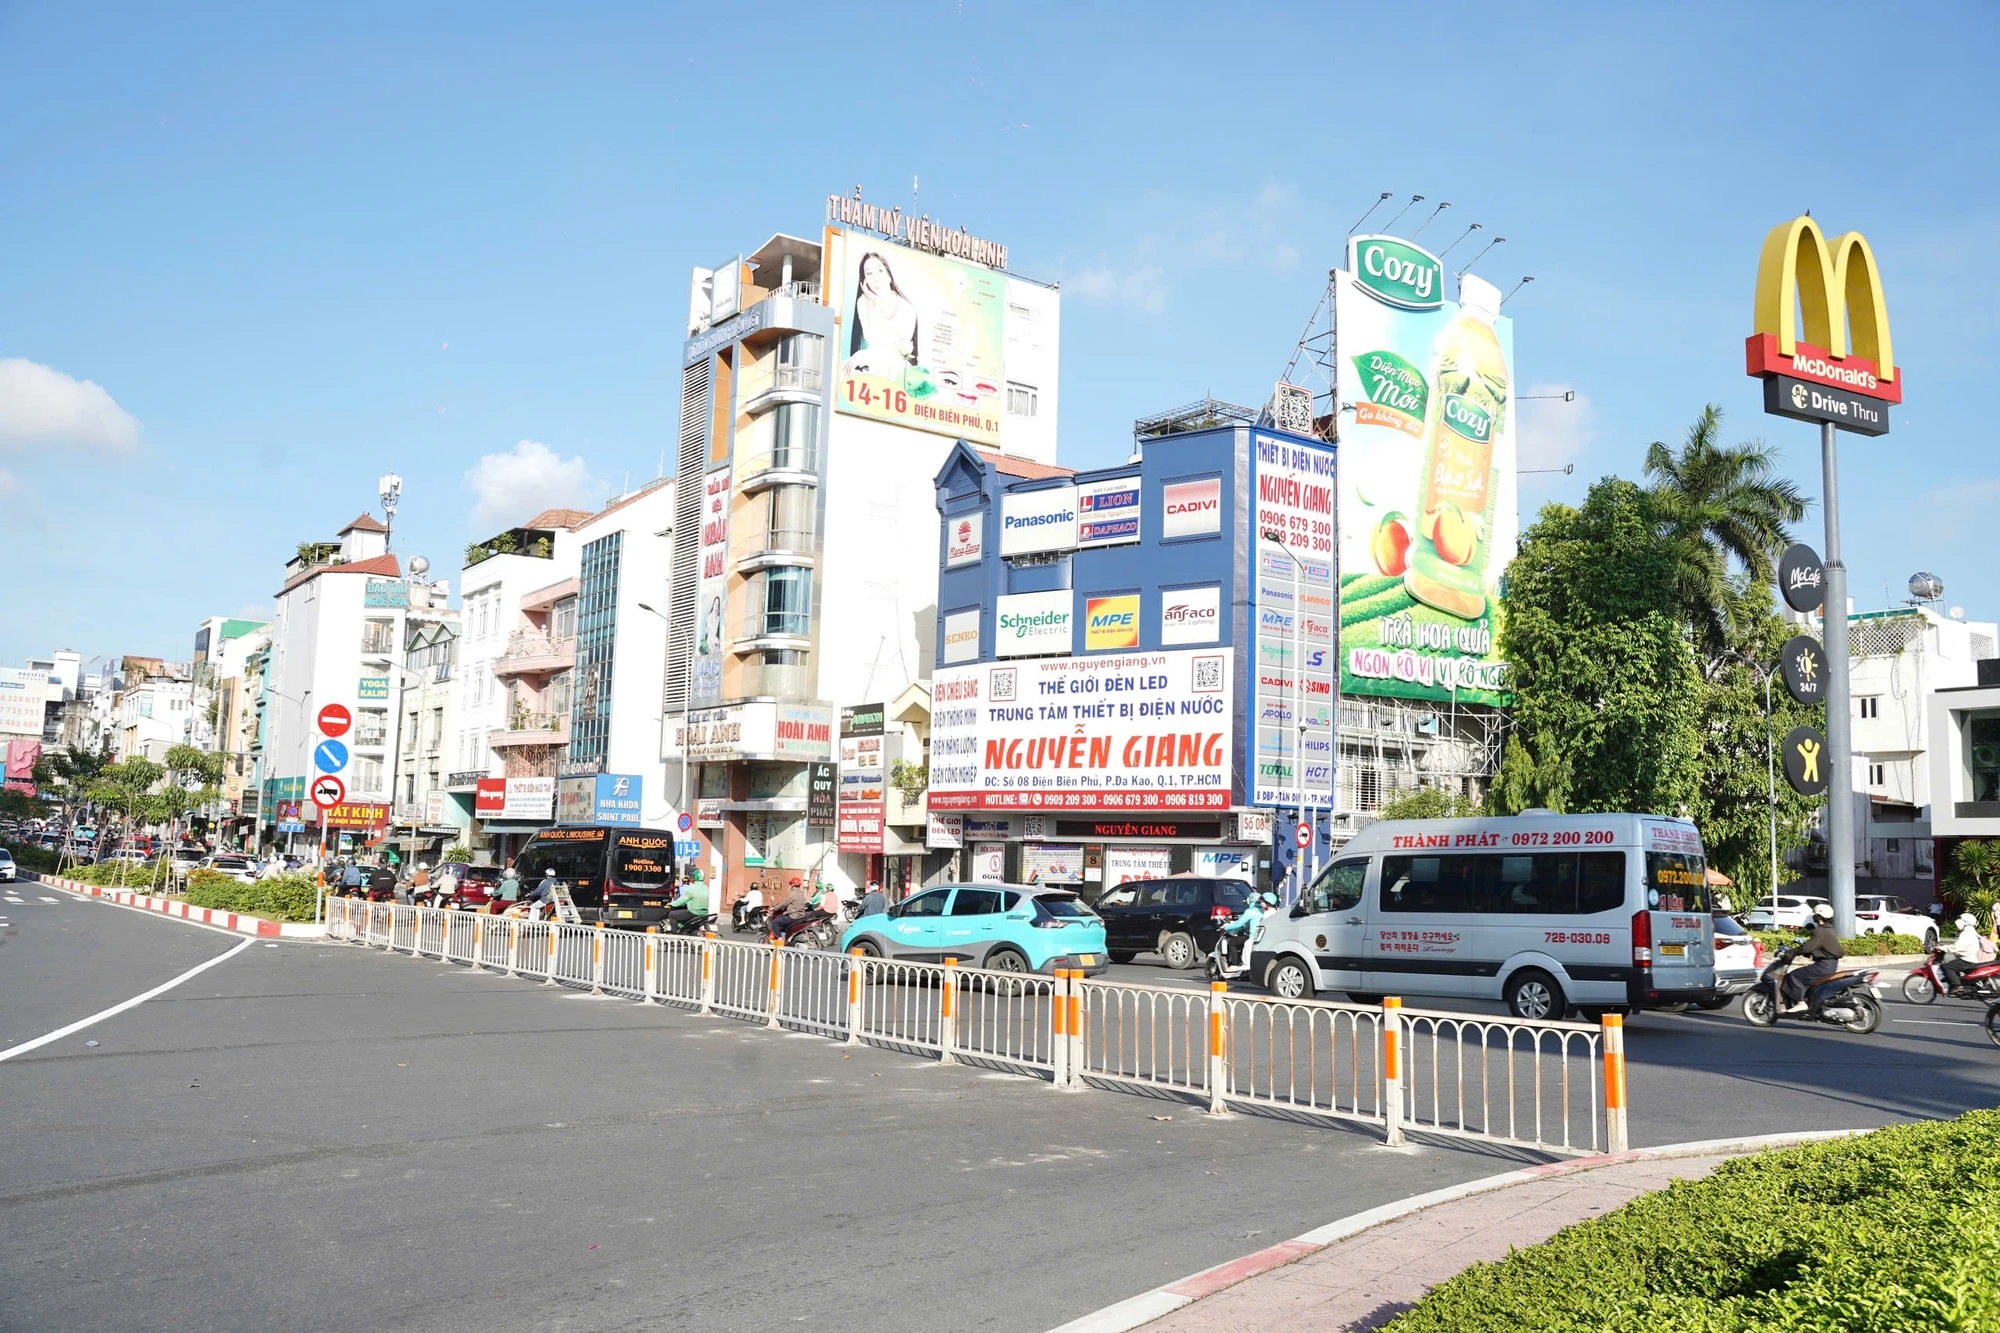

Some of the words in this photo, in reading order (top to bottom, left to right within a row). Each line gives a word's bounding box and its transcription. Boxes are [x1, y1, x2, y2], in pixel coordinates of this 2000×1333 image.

[878, 205, 902, 238] MỸ
[941, 224, 978, 261] HOÀI
[1364, 245, 1433, 299] Cozy
[1371, 356, 1397, 376] Diện
[1793, 354, 1876, 390] McDonald's
[1372, 374, 1421, 412] Mới
[846, 379, 907, 414] 14-16
[914, 403, 937, 421] ĐIỆN
[939, 408, 961, 425] BIÊN
[986, 417, 999, 433] Q.1
[1812, 391, 1848, 416] Drive
[1850, 401, 1879, 423] Thru
[1359, 407, 1374, 420] Gu
[1375, 409, 1403, 428] không
[1446, 398, 1489, 437] Cozy
[1257, 439, 1279, 465] THIẾT
[1282, 447, 1290, 471] BỊ
[1292, 448, 1311, 475] ĐIỆN
[1098, 492, 1134, 508] LION
[1260, 473, 1300, 508] NGUYỄN
[1303, 484, 1331, 515] GIANG
[1166, 499, 1217, 515] CADIVI
[1004, 509, 1075, 530] Panasonic
[1260, 509, 1286, 527] 0906
[1289, 515, 1308, 532] 679
[1311, 520, 1331, 537] 300
[1093, 522, 1137, 535] DAPHACO
[1290, 531, 1309, 548] 209
[1312, 536, 1331, 552] 300
[1790, 567, 1821, 588] McCafé
[1261, 587, 1294, 600] Panasonic
[1000, 611, 1070, 629] Schneider
[1090, 612, 1135, 628] MPE
[1261, 613, 1294, 628] MPE
[945, 630, 978, 645] SENKO
[1028, 626, 1068, 637] Electric
[1381, 611, 1413, 648] TRÀ
[1416, 623, 1452, 652] HOA
[1456, 618, 1490, 656] QUẢ
[1041, 656, 1166, 673] www.nguyengiang.vn
[1354, 650, 1391, 676] NGON
[1396, 651, 1414, 678] RÕ
[1459, 658, 1475, 685] RÕ
[934, 679, 946, 702] ĐÈN
[946, 674, 963, 701] CHIẾU
[963, 675, 979, 699] SÁNG
[1038, 675, 1068, 695] THẾ
[1069, 674, 1098, 694] GIỚI
[1104, 672, 1137, 693] ĐÈN
[1140, 675, 1168, 692] LED
[1261, 676, 1293, 689] CADIVI
[1311, 682, 1330, 695] SINO
[1799, 683, 1817, 693] 24/7
[360, 690, 388, 698] KALIN
[989, 707, 1034, 722] TRUNG
[1039, 702, 1069, 721] TÂM
[1073, 698, 1115, 718] THIẾT
[1119, 703, 1134, 721] BỊ
[1138, 697, 1176, 721] ĐIỆN
[1180, 694, 1224, 714] NƯỚC
[1263, 708, 1292, 720] APOLLO
[709, 723, 741, 745] ANH
[778, 720, 804, 742] HOÀI
[807, 724, 830, 742] ANH
[985, 723, 1112, 770] NGUYỄN
[1122, 732, 1224, 769] GIANG
[1259, 764, 1293, 777] TOTAL
[1305, 766, 1330, 778] HCT
[813, 780, 832, 792] QUY
[984, 776, 1000, 787] ĐC:
[1002, 775, 1016, 787] Số
[1017, 776, 1029, 787] 08
[1032, 775, 1054, 788] Điện
[1056, 775, 1078, 787] Biên
[1081, 773, 1102, 788] Phủ,
[1106, 776, 1131, 786] P.Đa
[1133, 776, 1154, 788] Kao,
[1157, 775, 1177, 788] Q.1,
[1180, 775, 1222, 786] TP.HCM
[600, 799, 617, 809] NHA
[618, 800, 639, 810] KHOA
[812, 792, 832, 804] HÒA
[930, 795, 978, 807] www.nguyengiang.vn
[985, 793, 1018, 806] HOTLINE:
[1044, 793, 1063, 806] 0909
[1065, 793, 1080, 806] 209
[1081, 793, 1097, 806] 300
[1103, 793, 1124, 806] 0906
[1125, 793, 1140, 806] 679
[1142, 793, 1158, 806] 300
[1165, 792, 1186, 805] 0906
[1187, 792, 1204, 805] 819
[1206, 792, 1223, 805] 300
[1262, 791, 1274, 801] ĐBP
[1279, 790, 1290, 802] TÂN
[1311, 794, 1333, 804] TP.HCM
[810, 804, 834, 817] PHÁT
[598, 813, 619, 822] SAINT
[621, 814, 641, 824] PAUL
[932, 816, 945, 825] THẾ
[946, 817, 961, 826] GIỚI
[964, 818, 1009, 831] Panasonic
[1243, 816, 1254, 830] Số
[1255, 817, 1265, 831] 08
[566, 830, 597, 839] LIMOUSINE
[1094, 822, 1139, 836] NGUYỄN
[1140, 824, 1177, 836] GIANG
[1651, 825, 1681, 840] THÀNH
[619, 836, 639, 845] ANH
[641, 837, 668, 848] QUỐC
[1392, 833, 1450, 848] THÀNH
[1455, 831, 1501, 848] PHÁT
[1511, 832, 1548, 846] 0972
[1552, 832, 1580, 845] 200
[1584, 831, 1614, 844] 200
[633, 858, 655, 866] Hotline
[1089, 855, 1098, 865] 8
[1111, 860, 1132, 868] TRUNG
[1133, 859, 1147, 868] TÂM
[1148, 858, 1167, 869] THIẾT
[1202, 853, 1243, 865] MPE
[624, 864, 642, 873] 1900
[643, 864, 663, 873] 3300
[1380, 931, 1398, 940] 당신의
[1401, 931, 1419, 940] 열정을
